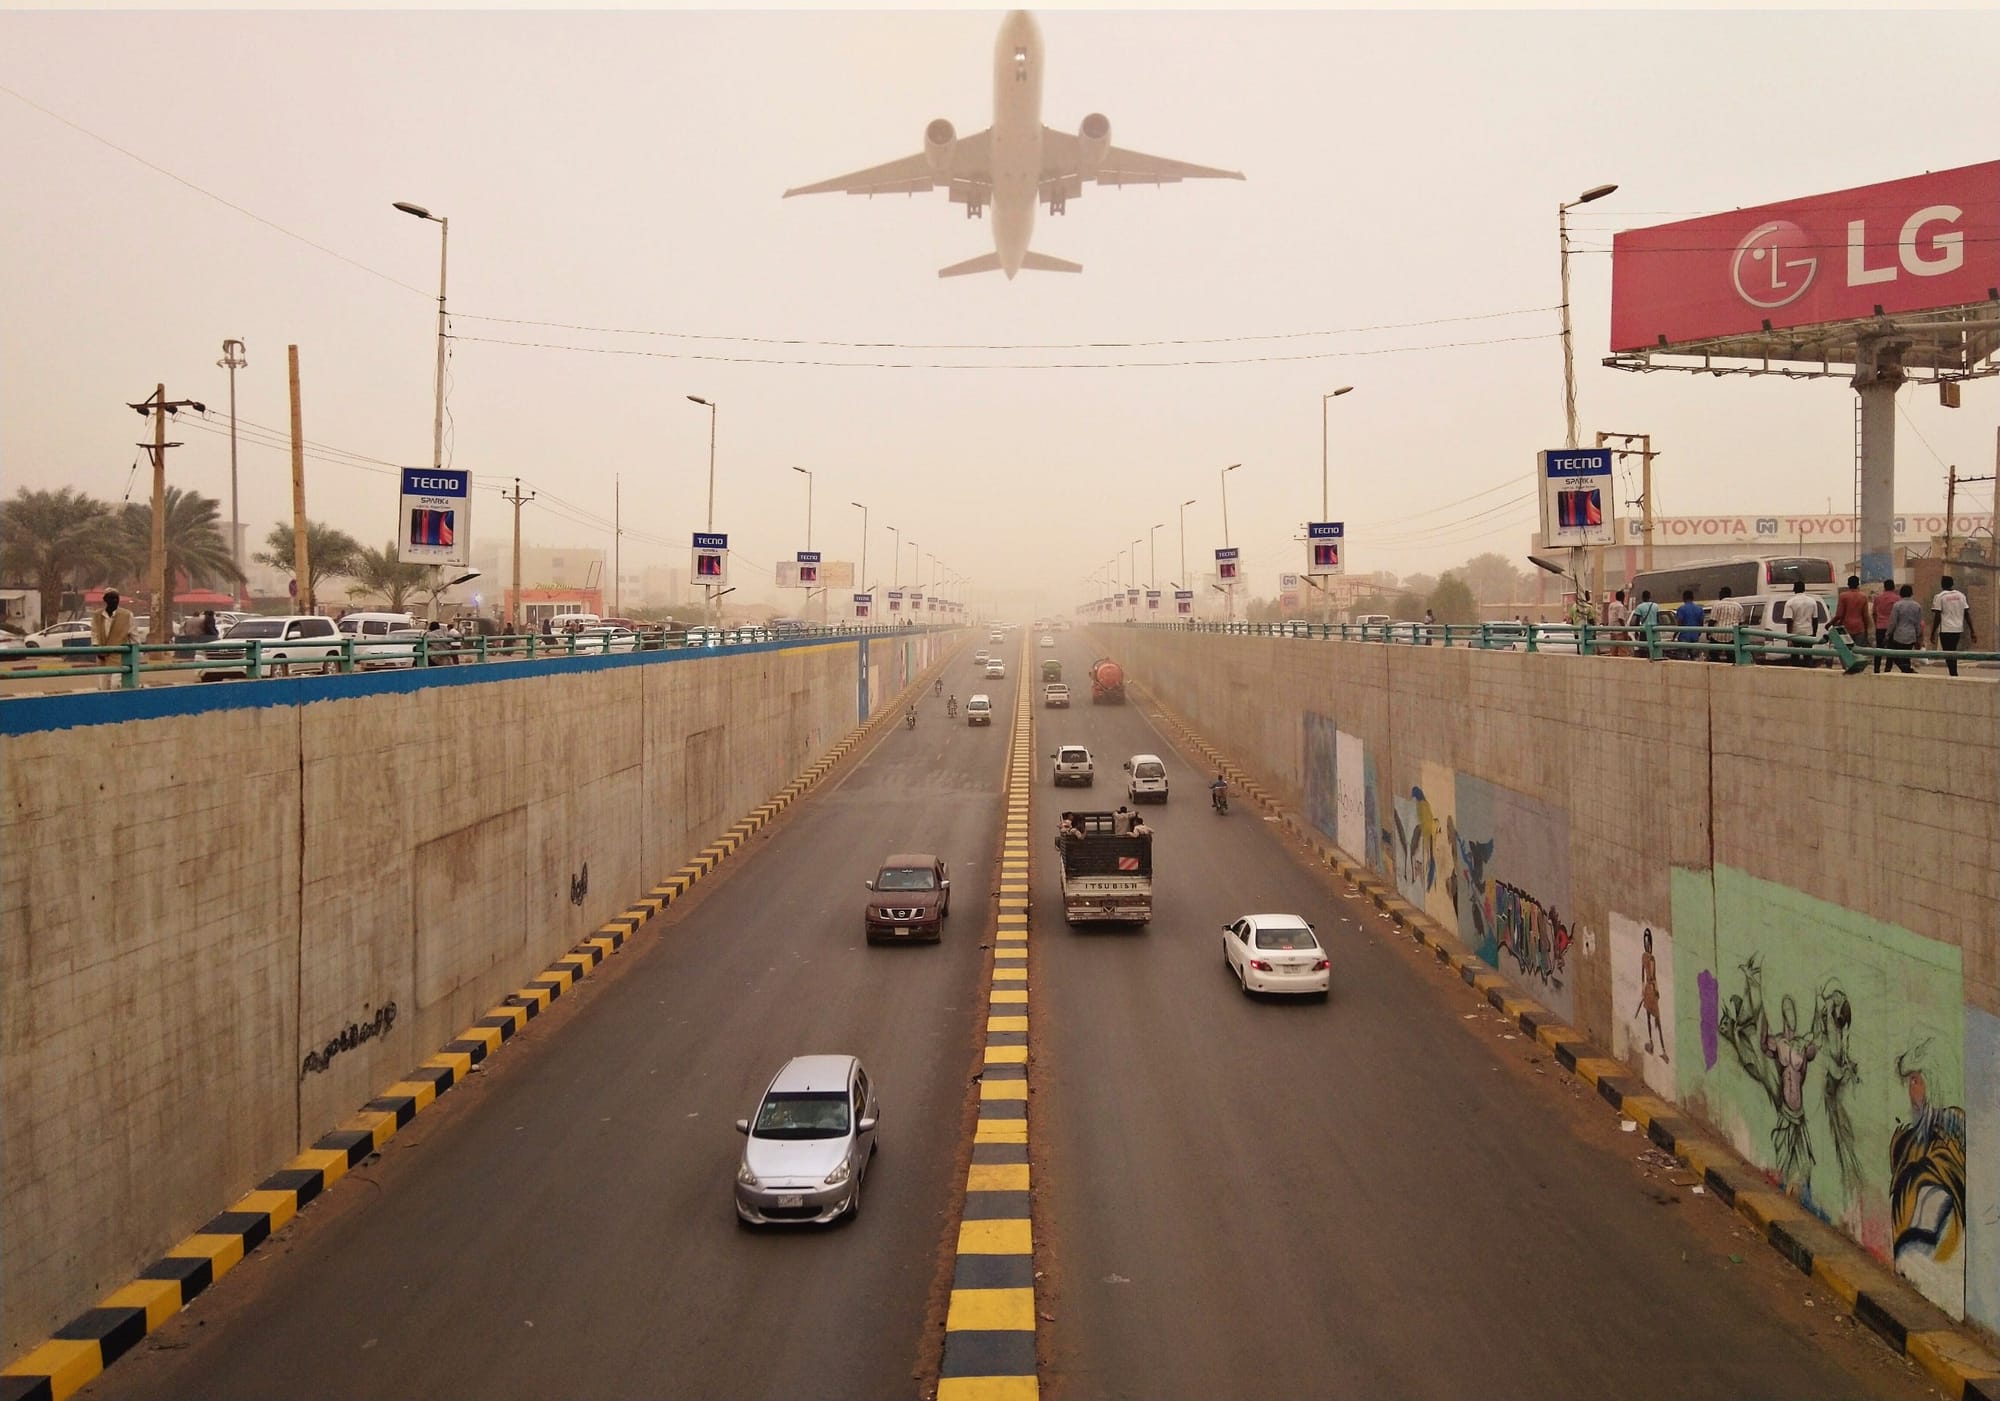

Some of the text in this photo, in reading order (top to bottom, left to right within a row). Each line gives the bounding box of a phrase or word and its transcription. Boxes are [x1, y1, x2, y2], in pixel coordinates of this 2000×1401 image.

[1847, 204, 1964, 287] LG
[1554, 457, 1602, 470] TECNO
[411, 477, 458, 489] TECNO
[1659, 519, 1747, 534] TOYOTA
[1785, 518, 1861, 534] TOYOT
